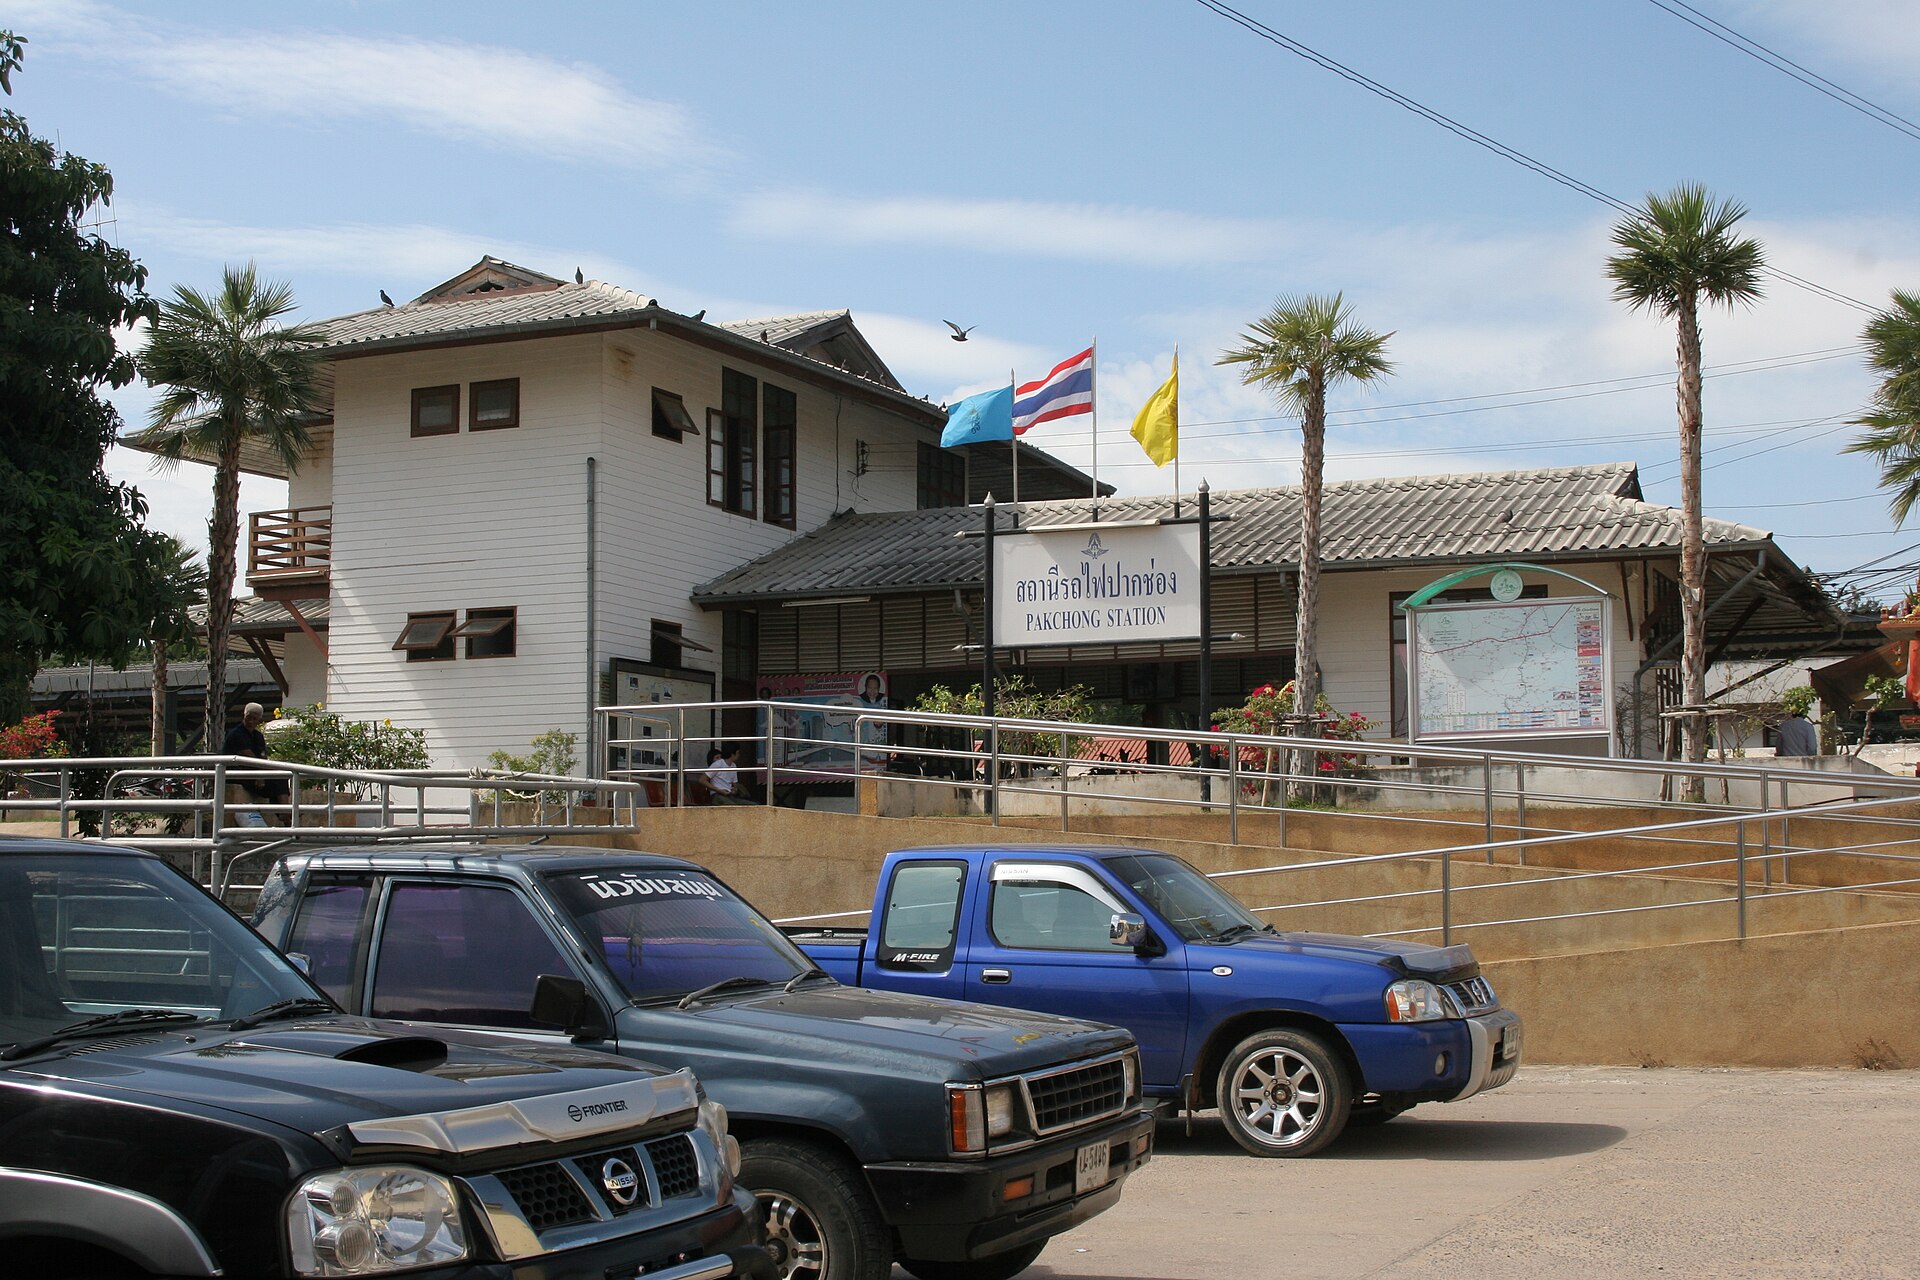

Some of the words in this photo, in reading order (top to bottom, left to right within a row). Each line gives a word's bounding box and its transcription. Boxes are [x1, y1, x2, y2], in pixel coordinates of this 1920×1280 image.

[1016, 557, 1177, 603] สถานีรถไฟปากช่อง
[1026, 609, 1100, 632] PAKCHONG
[1107, 606, 1166, 628] STATION
[582, 1100, 628, 1117] FRONTIER
